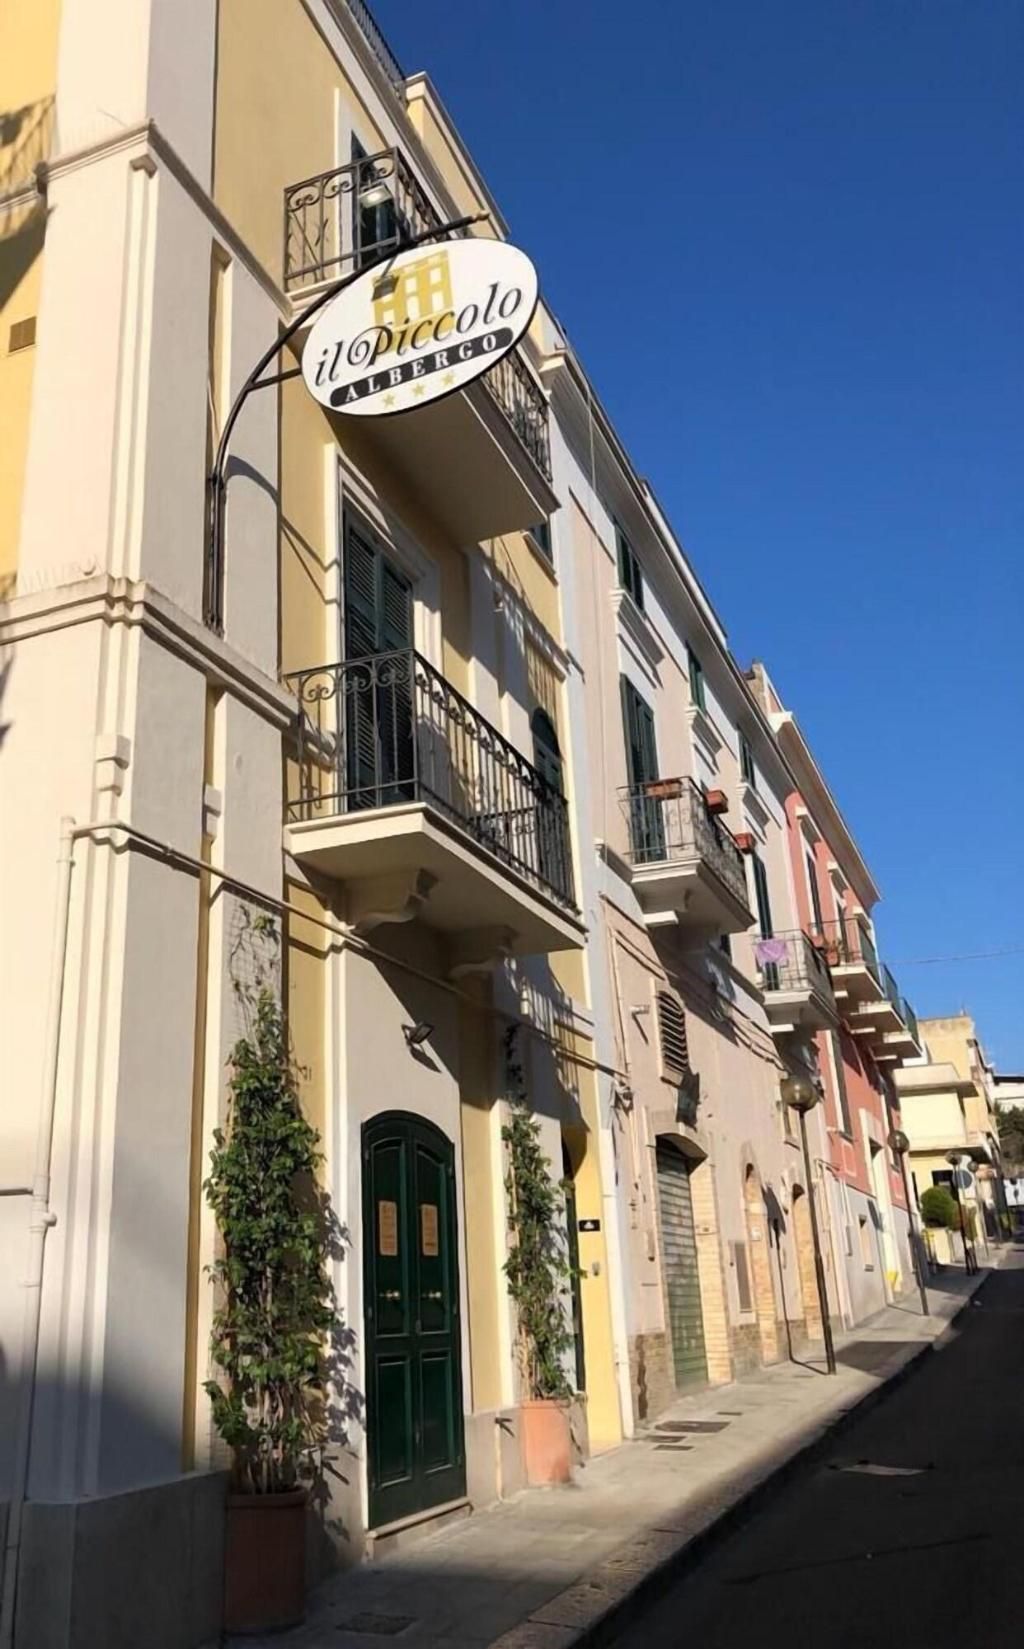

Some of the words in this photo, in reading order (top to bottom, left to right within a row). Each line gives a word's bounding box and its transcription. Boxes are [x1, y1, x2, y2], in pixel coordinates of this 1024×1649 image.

[315, 340, 342, 387] il
[347, 281, 522, 371] Piccolo
[345, 335, 497, 402] ALBERGO
